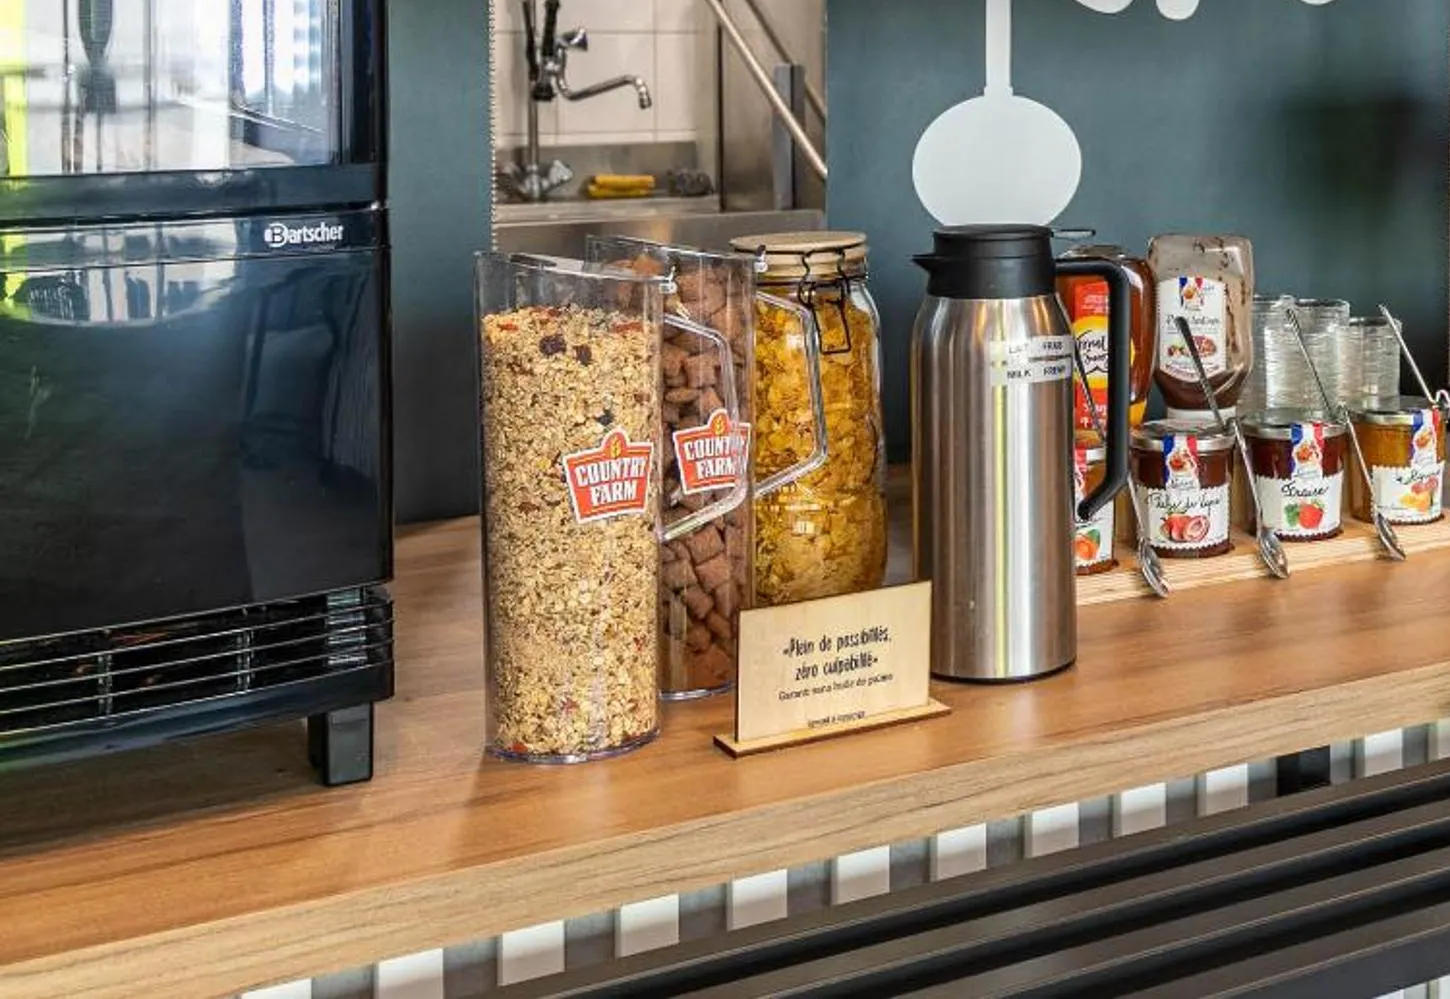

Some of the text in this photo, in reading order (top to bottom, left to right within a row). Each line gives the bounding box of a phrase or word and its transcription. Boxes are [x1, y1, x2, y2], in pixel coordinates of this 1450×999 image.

[264, 221, 344, 248] Bartscher
[576, 455, 647, 488] COUNTRY
[589, 480, 638, 507] FARM
[819, 635, 832, 652] de
[795, 661, 819, 681] zéro
